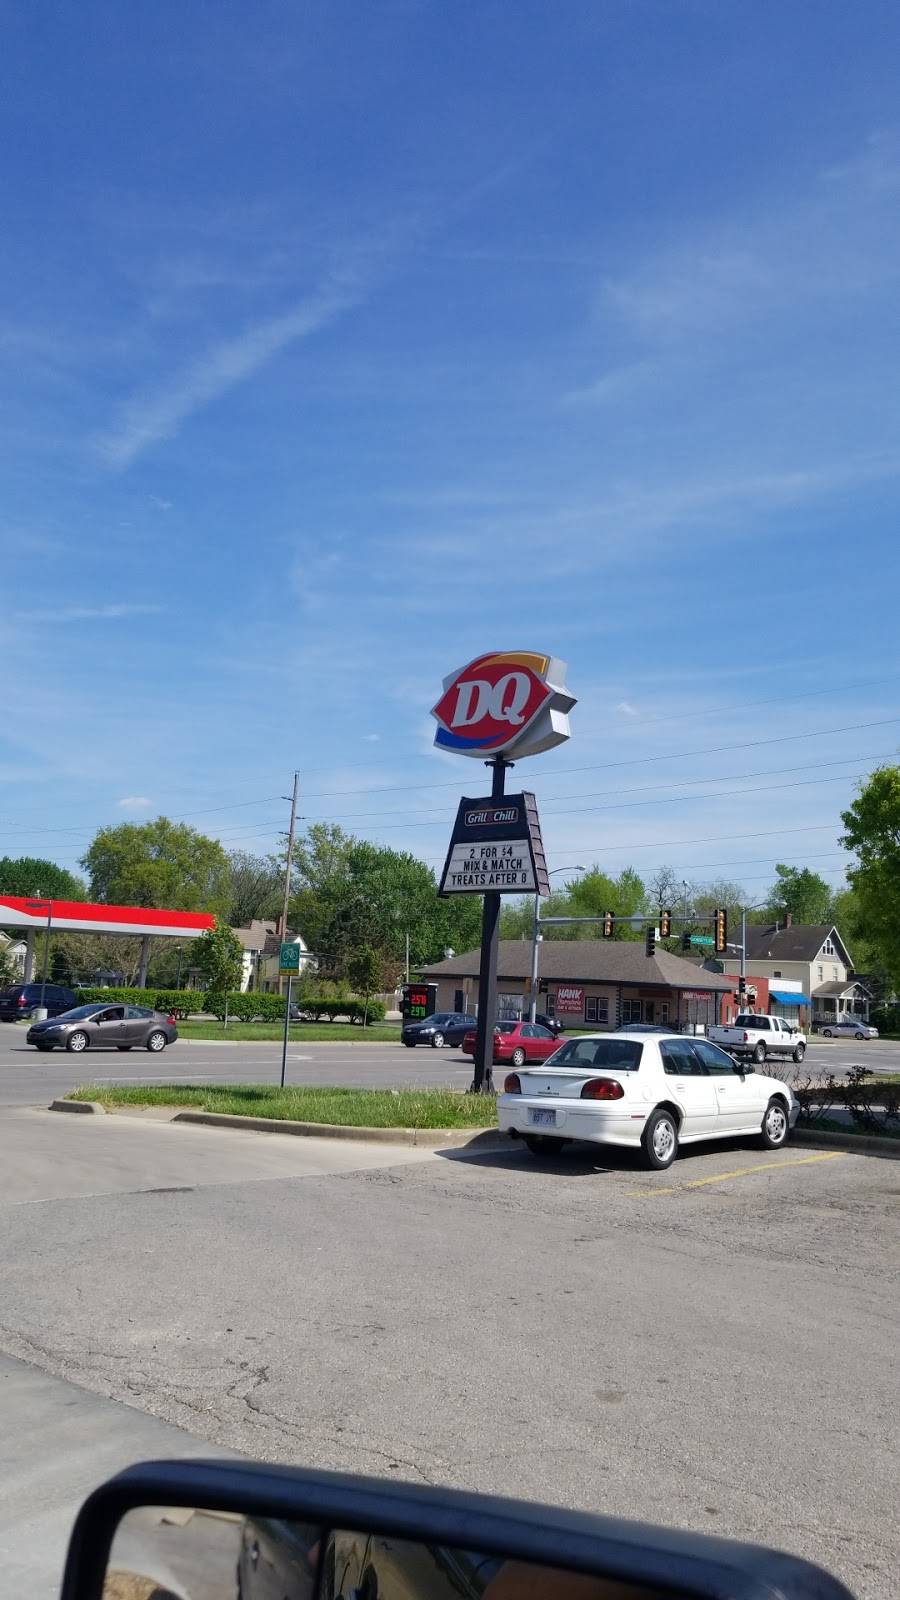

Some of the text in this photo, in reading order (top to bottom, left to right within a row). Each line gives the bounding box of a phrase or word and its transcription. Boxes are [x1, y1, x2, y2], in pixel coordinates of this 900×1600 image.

[450, 671, 531, 728] DQ
[467, 812, 487, 824] Grill
[493, 809, 515, 821] Chill
[469, 846, 513, 859] 2 FOR $4
[463, 858, 522, 872] MIX & MATCH
[452, 873, 486, 886] TREATS
[489, 872, 517, 884] AFTER
[558, 988, 582, 999] HANK
